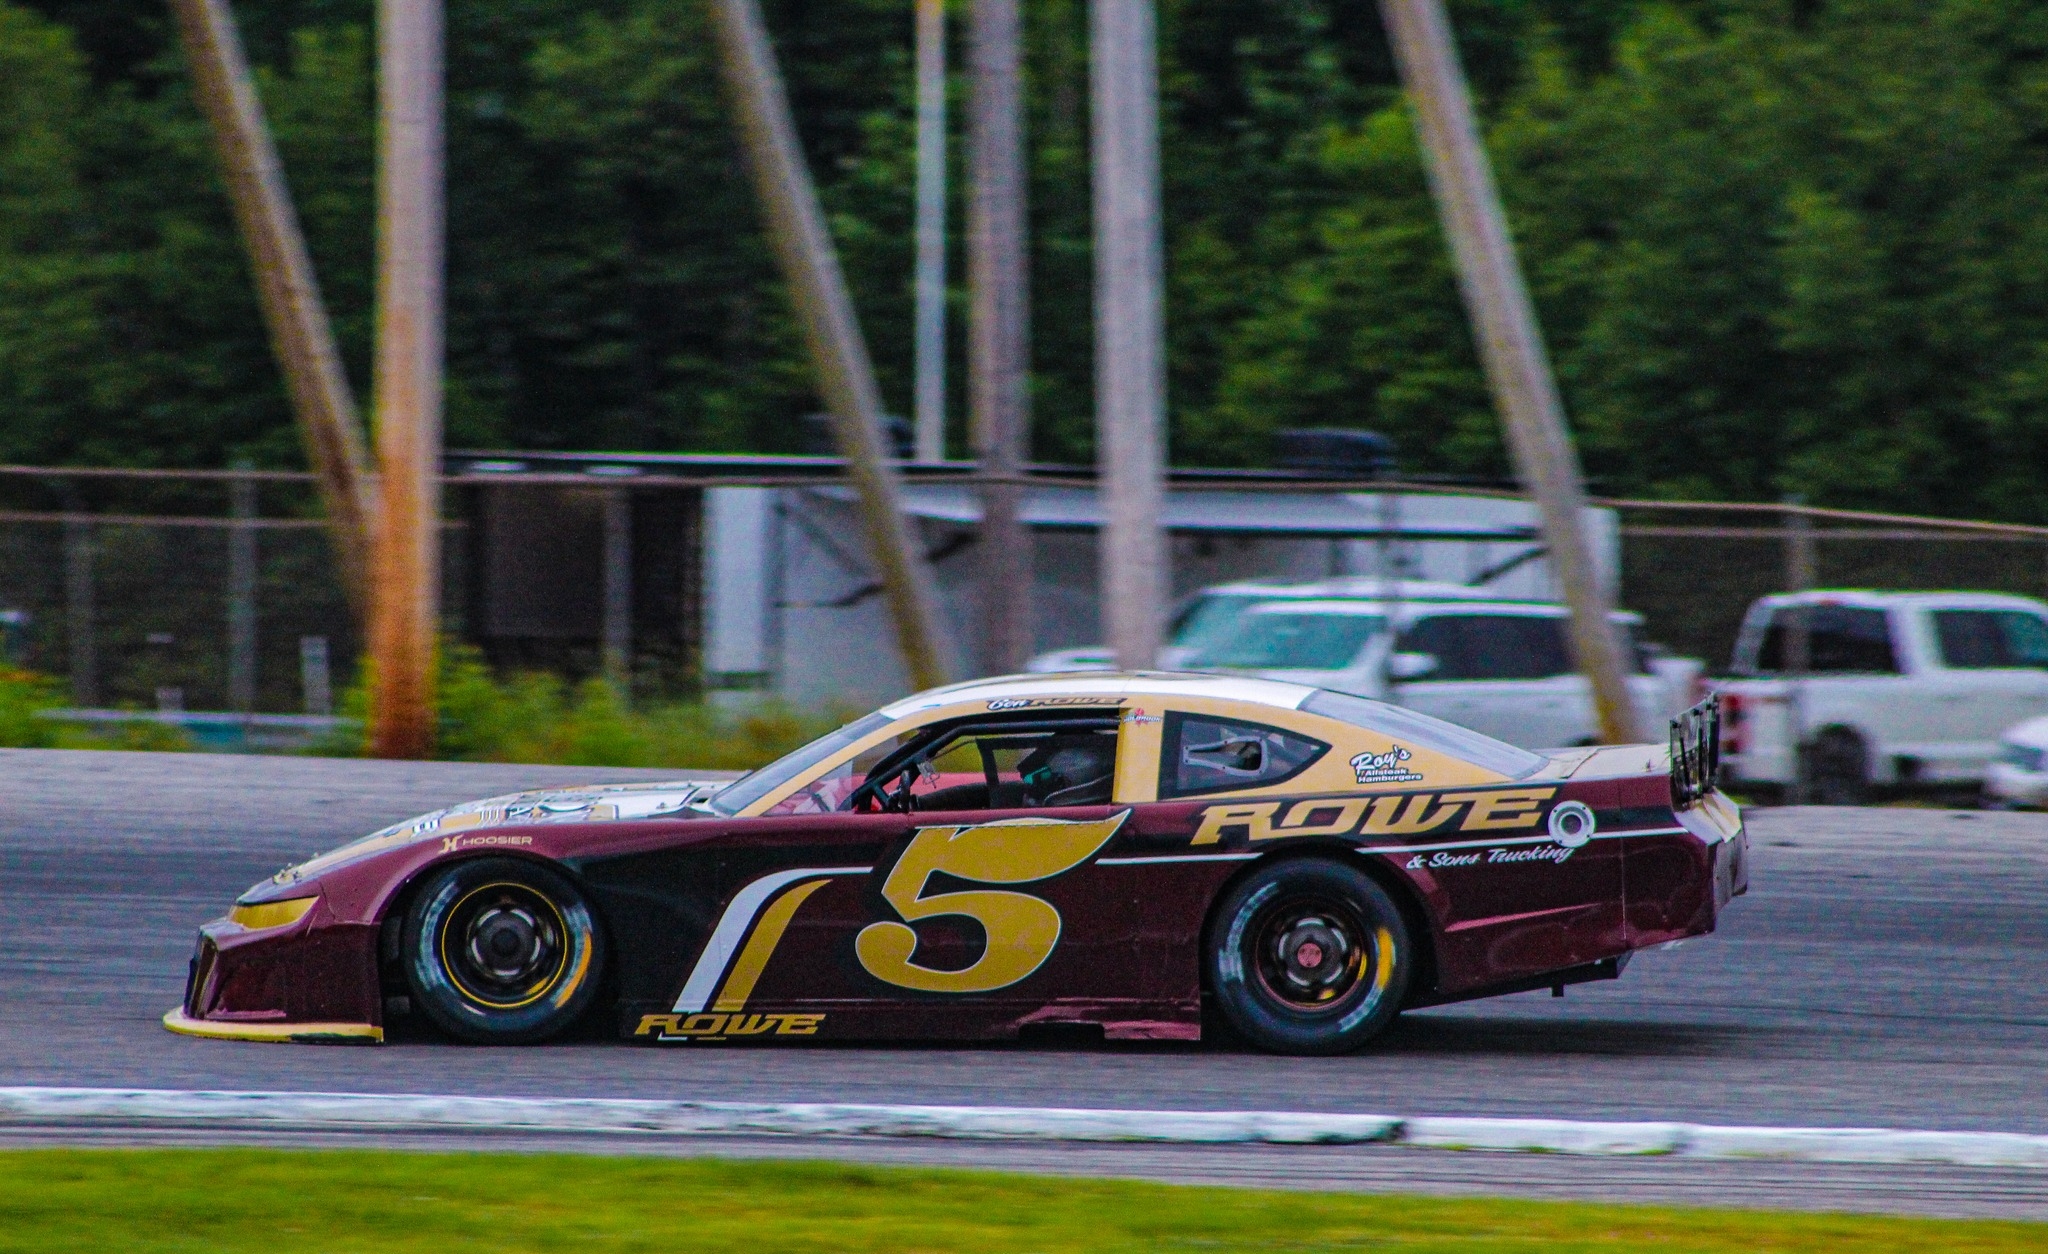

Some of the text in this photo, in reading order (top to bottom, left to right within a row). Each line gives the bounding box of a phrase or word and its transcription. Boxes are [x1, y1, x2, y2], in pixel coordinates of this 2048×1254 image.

[987, 698, 1032, 711] Ben
[1350, 744, 1411, 775] Roy's
[1357, 774, 1422, 783] Hamburgers
[1190, 788, 1557, 845] ROWE
[462, 835, 533, 846] HOOSIER
[1406, 845, 1575, 869] & Sons Trucking
[855, 808, 1132, 993] 5
[634, 1013, 827, 1036] ROWE
